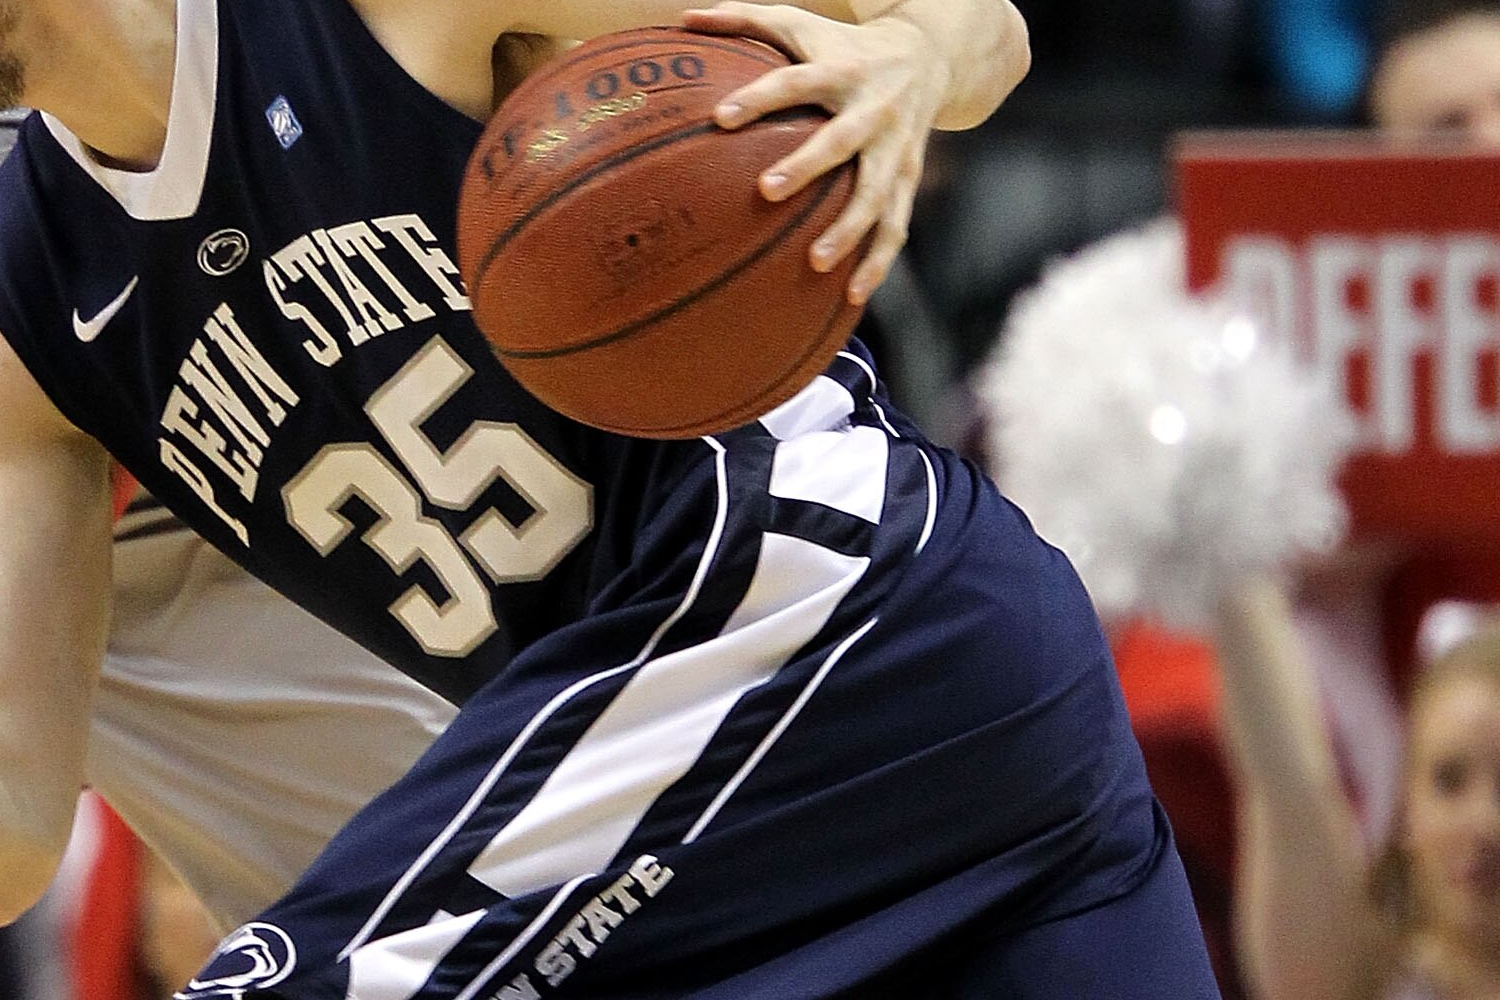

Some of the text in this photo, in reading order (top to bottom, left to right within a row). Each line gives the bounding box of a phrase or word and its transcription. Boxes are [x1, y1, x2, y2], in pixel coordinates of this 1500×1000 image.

[156, 212, 475, 549] PENN STATE
[279, 332, 596, 659] 35
[534, 854, 676, 988] STATE
